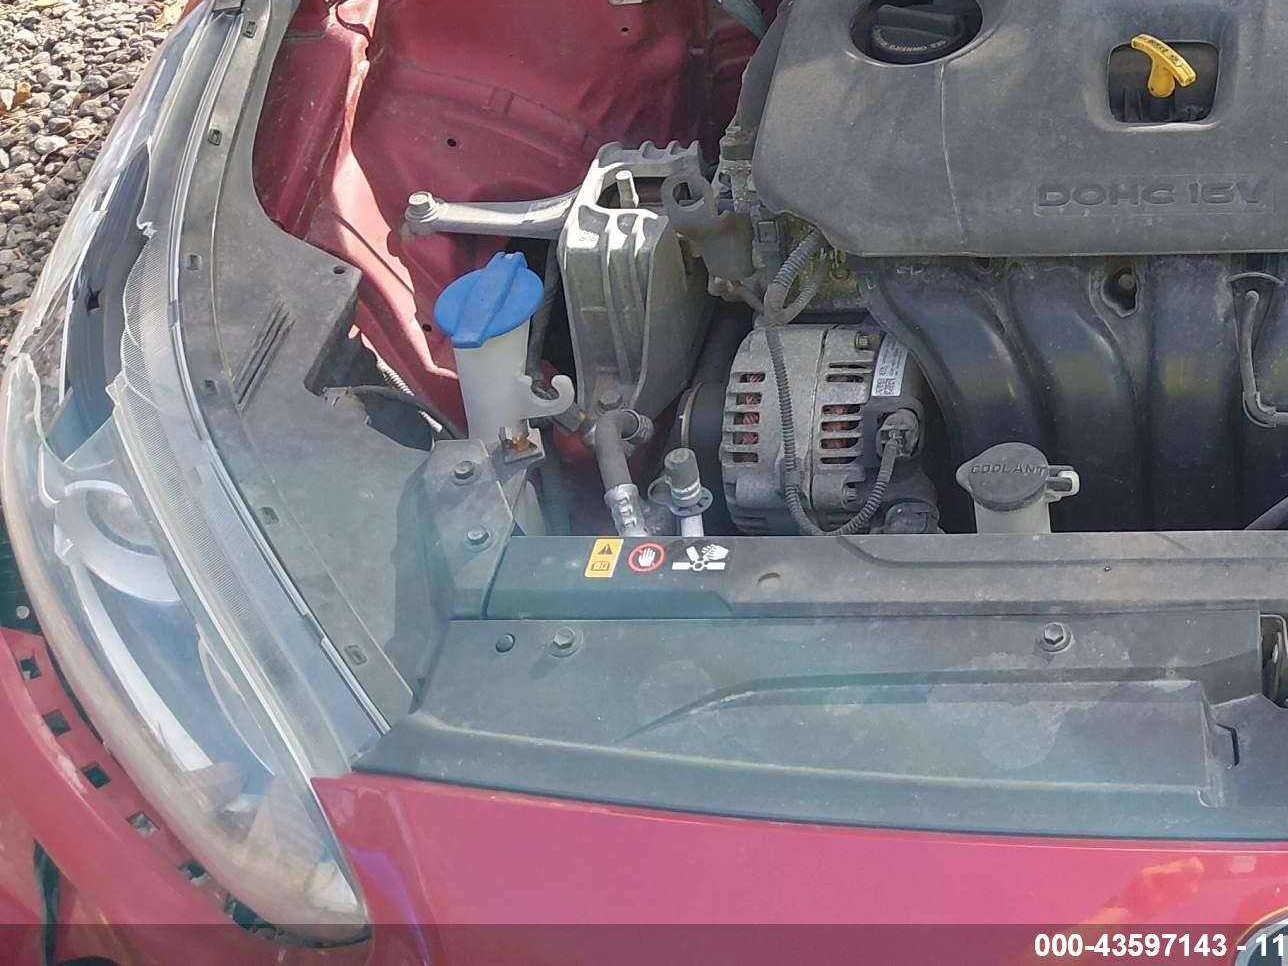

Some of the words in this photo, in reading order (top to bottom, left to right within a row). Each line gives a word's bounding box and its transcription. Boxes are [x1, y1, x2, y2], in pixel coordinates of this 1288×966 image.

[1038, 183, 1177, 207] DOHC
[1188, 181, 1270, 206] 16V
[970, 463, 1048, 475] COOLANT
